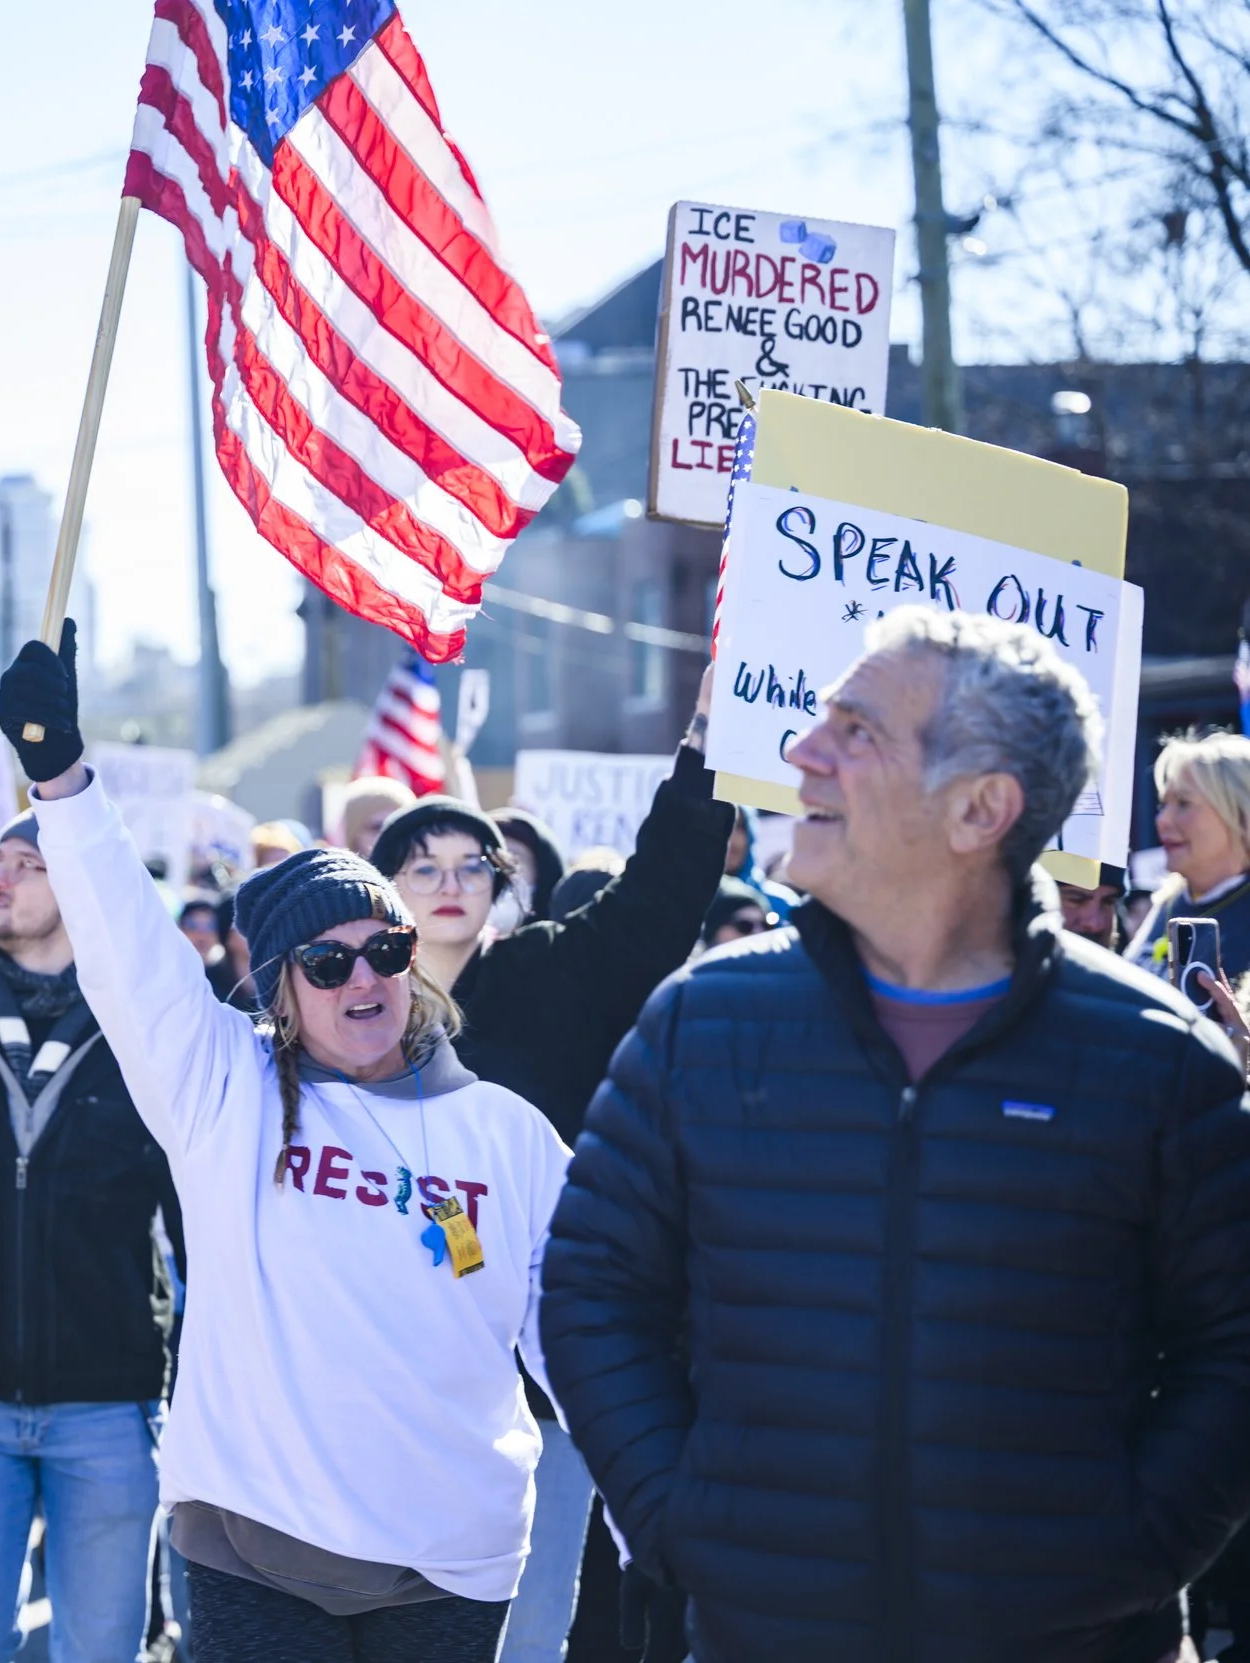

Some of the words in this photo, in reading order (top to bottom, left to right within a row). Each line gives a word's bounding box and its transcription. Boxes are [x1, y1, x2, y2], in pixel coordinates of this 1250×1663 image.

[688, 207, 756, 243] ICE
[679, 241, 880, 315] MURDERED
[681, 296, 777, 337] RENEE
[784, 308, 863, 348] GOOD
[755, 336, 790, 378] &
[678, 368, 732, 400] THE
[688, 402, 740, 440] PRE
[671, 438, 736, 473] LIE
[776, 506, 960, 611] SPEAK
[986, 574, 1105, 653] OUT
[733, 661, 817, 716] While
[533, 761, 671, 805] JUSTIC
[285, 1145, 488, 1233] RESST
